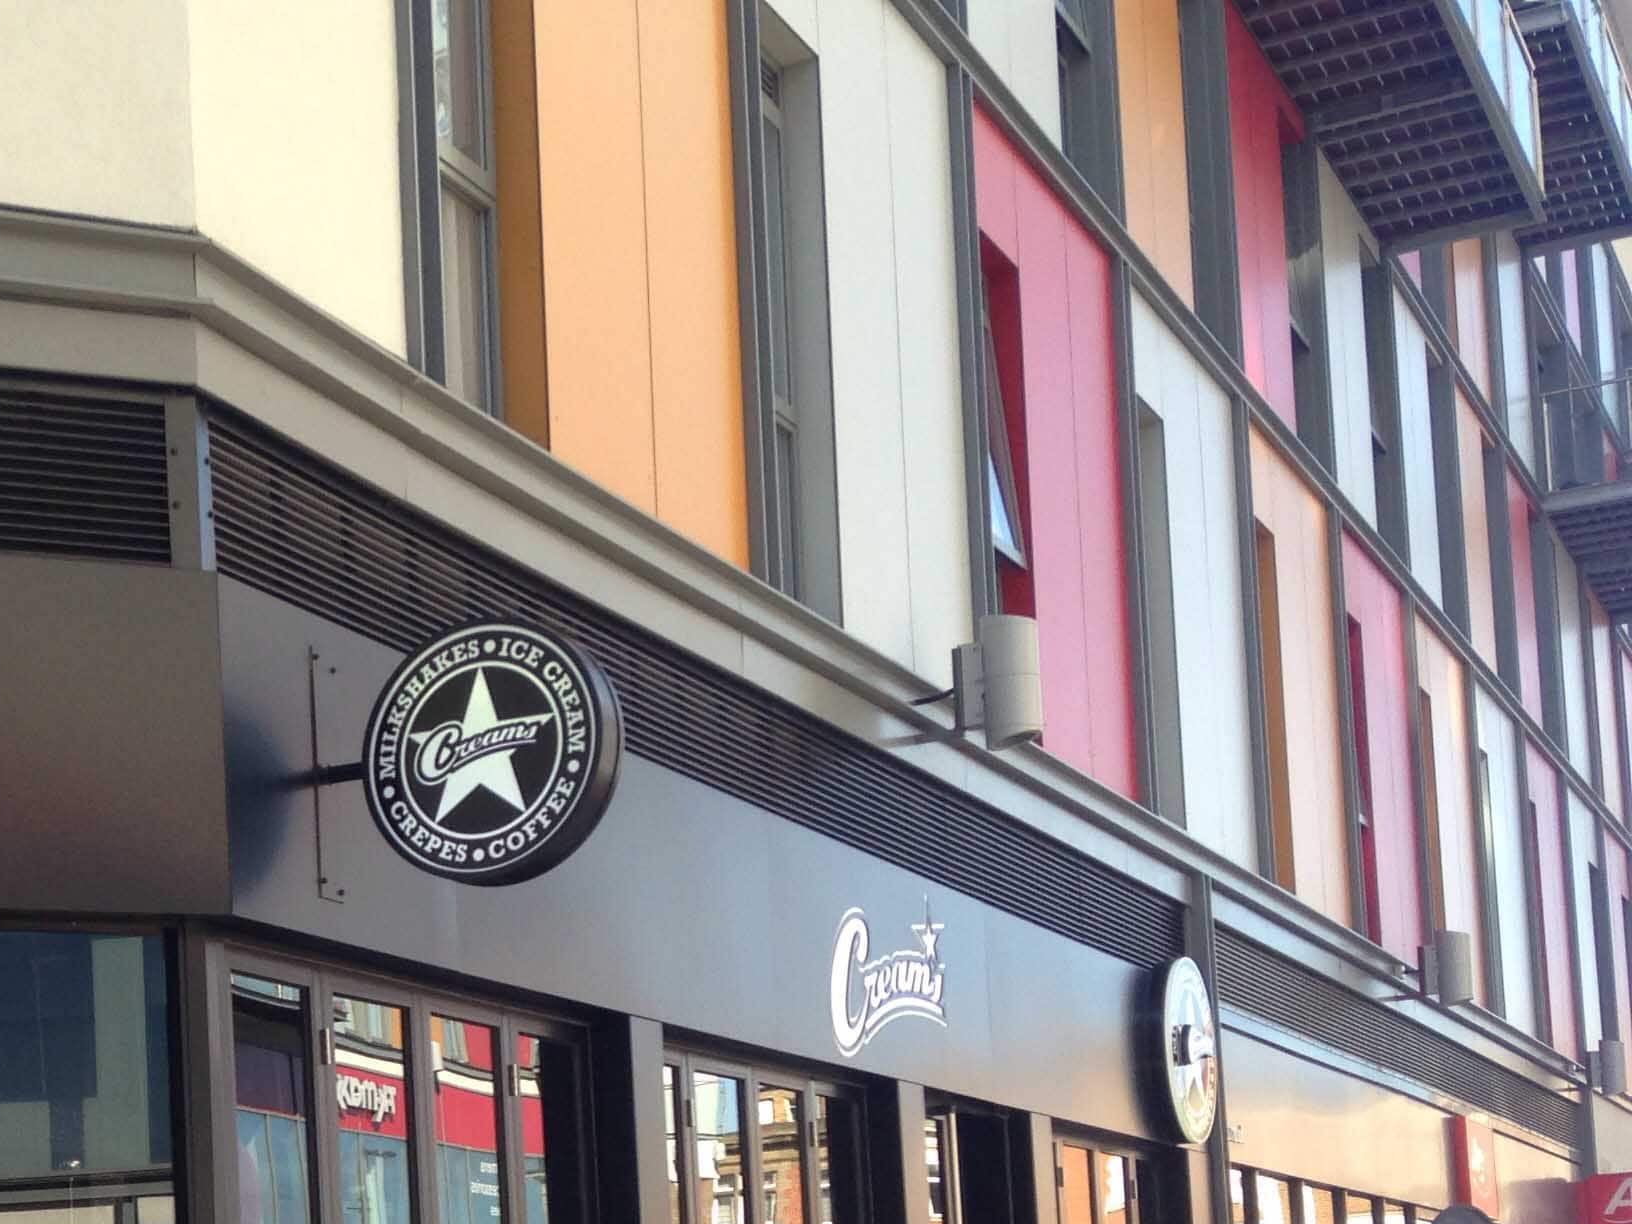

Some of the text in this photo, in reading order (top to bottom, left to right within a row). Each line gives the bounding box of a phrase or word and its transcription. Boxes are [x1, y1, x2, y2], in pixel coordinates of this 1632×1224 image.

[378, 638, 587, 780] MILKSHAKES ICE CREAM
[415, 720, 538, 786] Creams
[390, 776, 576, 864] CREPES COFFEE
